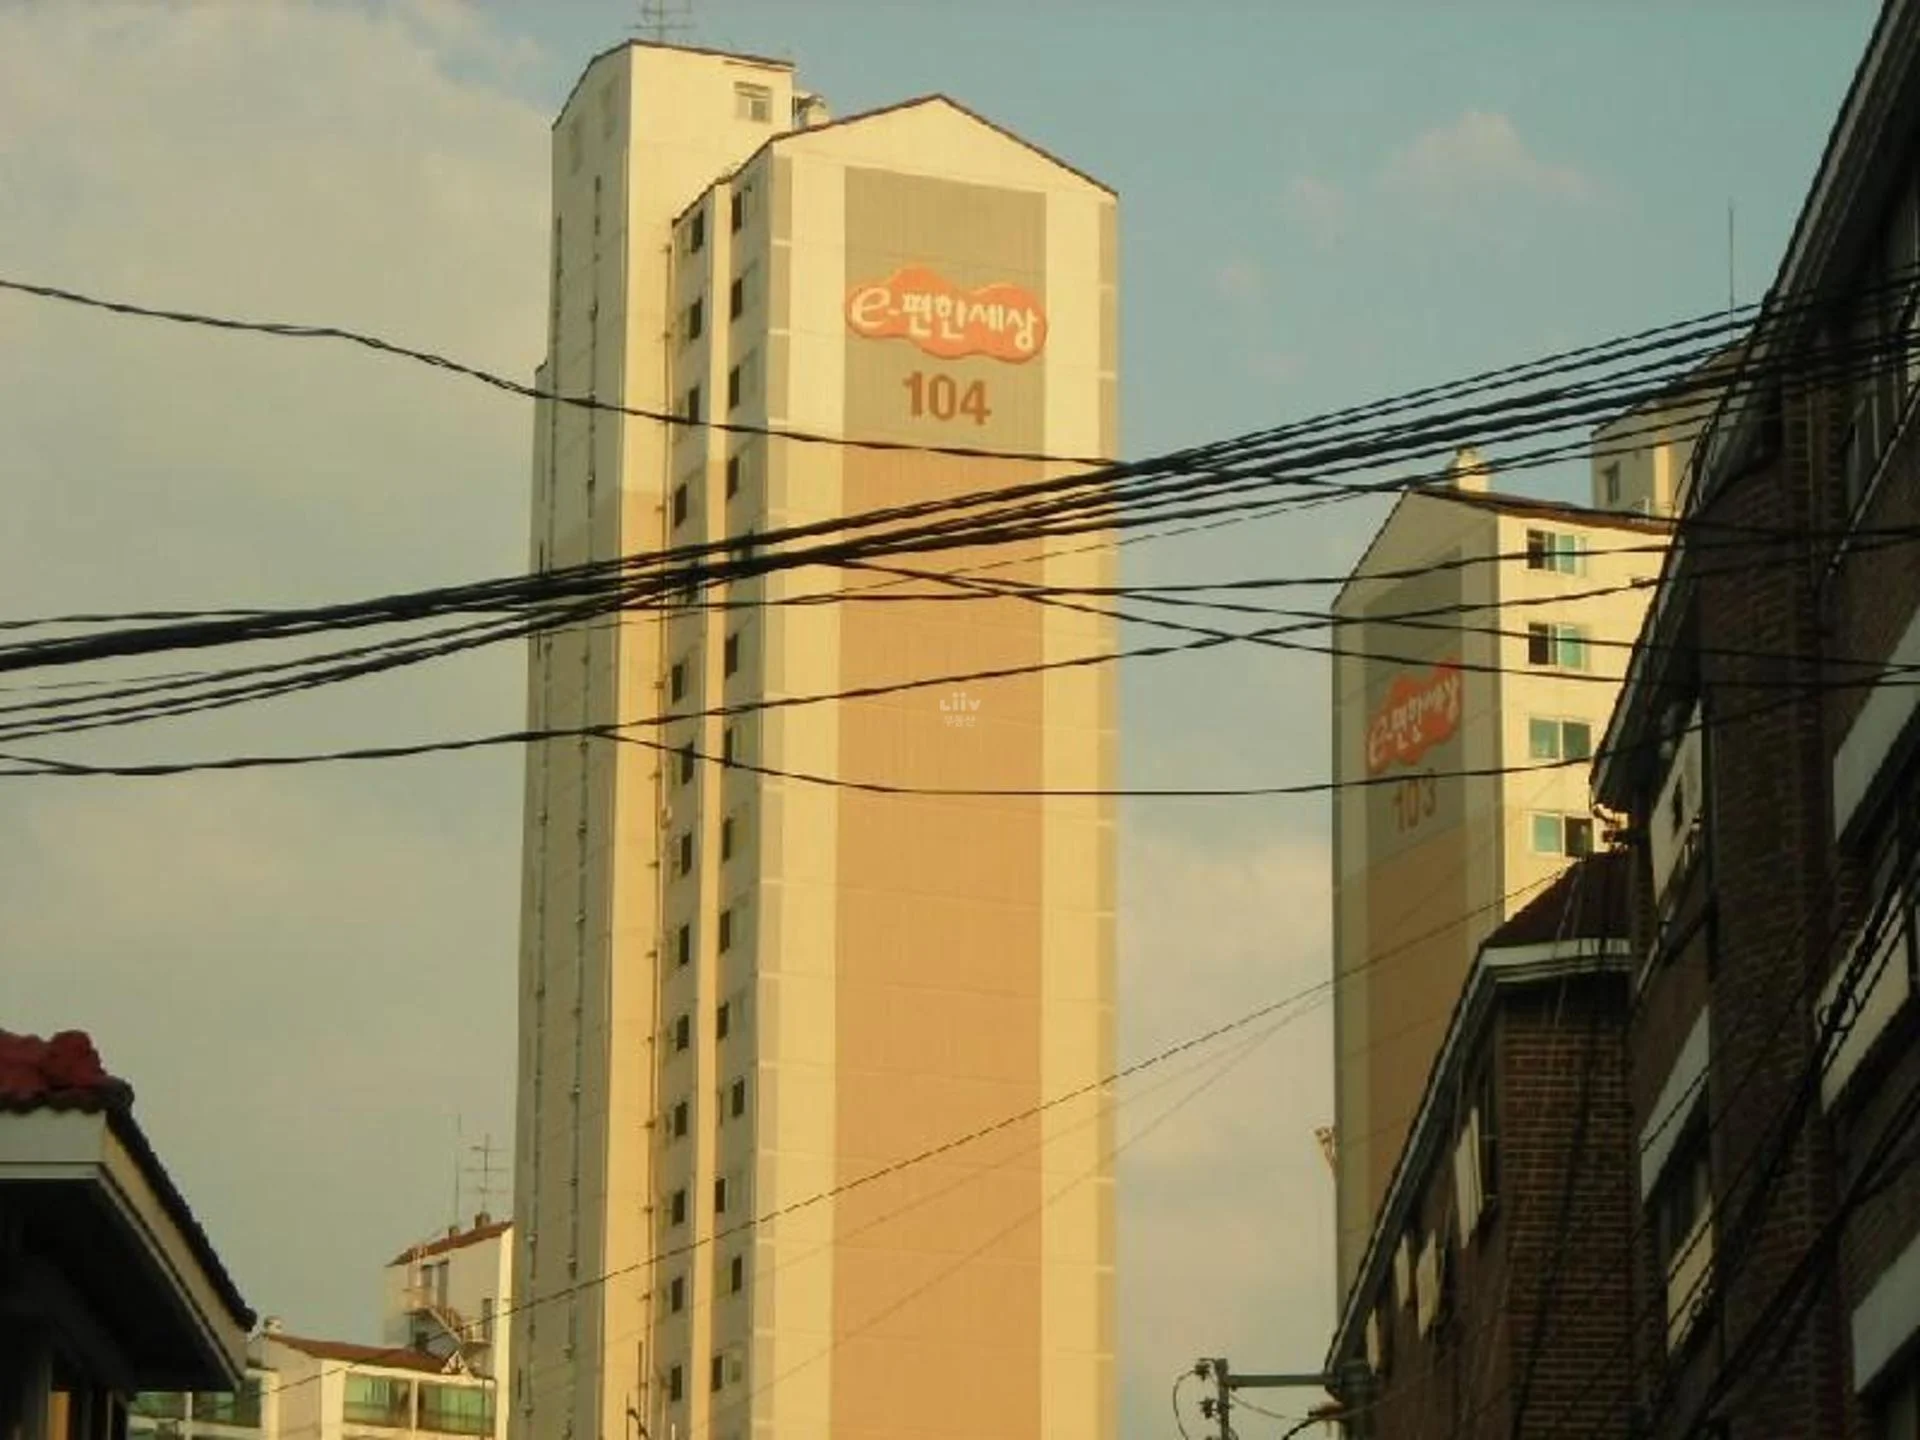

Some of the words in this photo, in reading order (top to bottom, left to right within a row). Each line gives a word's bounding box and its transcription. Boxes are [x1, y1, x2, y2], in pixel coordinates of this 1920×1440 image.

[851, 286, 1038, 352] e-편한세상
[903, 371, 992, 425] 104
[1393, 769, 1436, 833] 103
